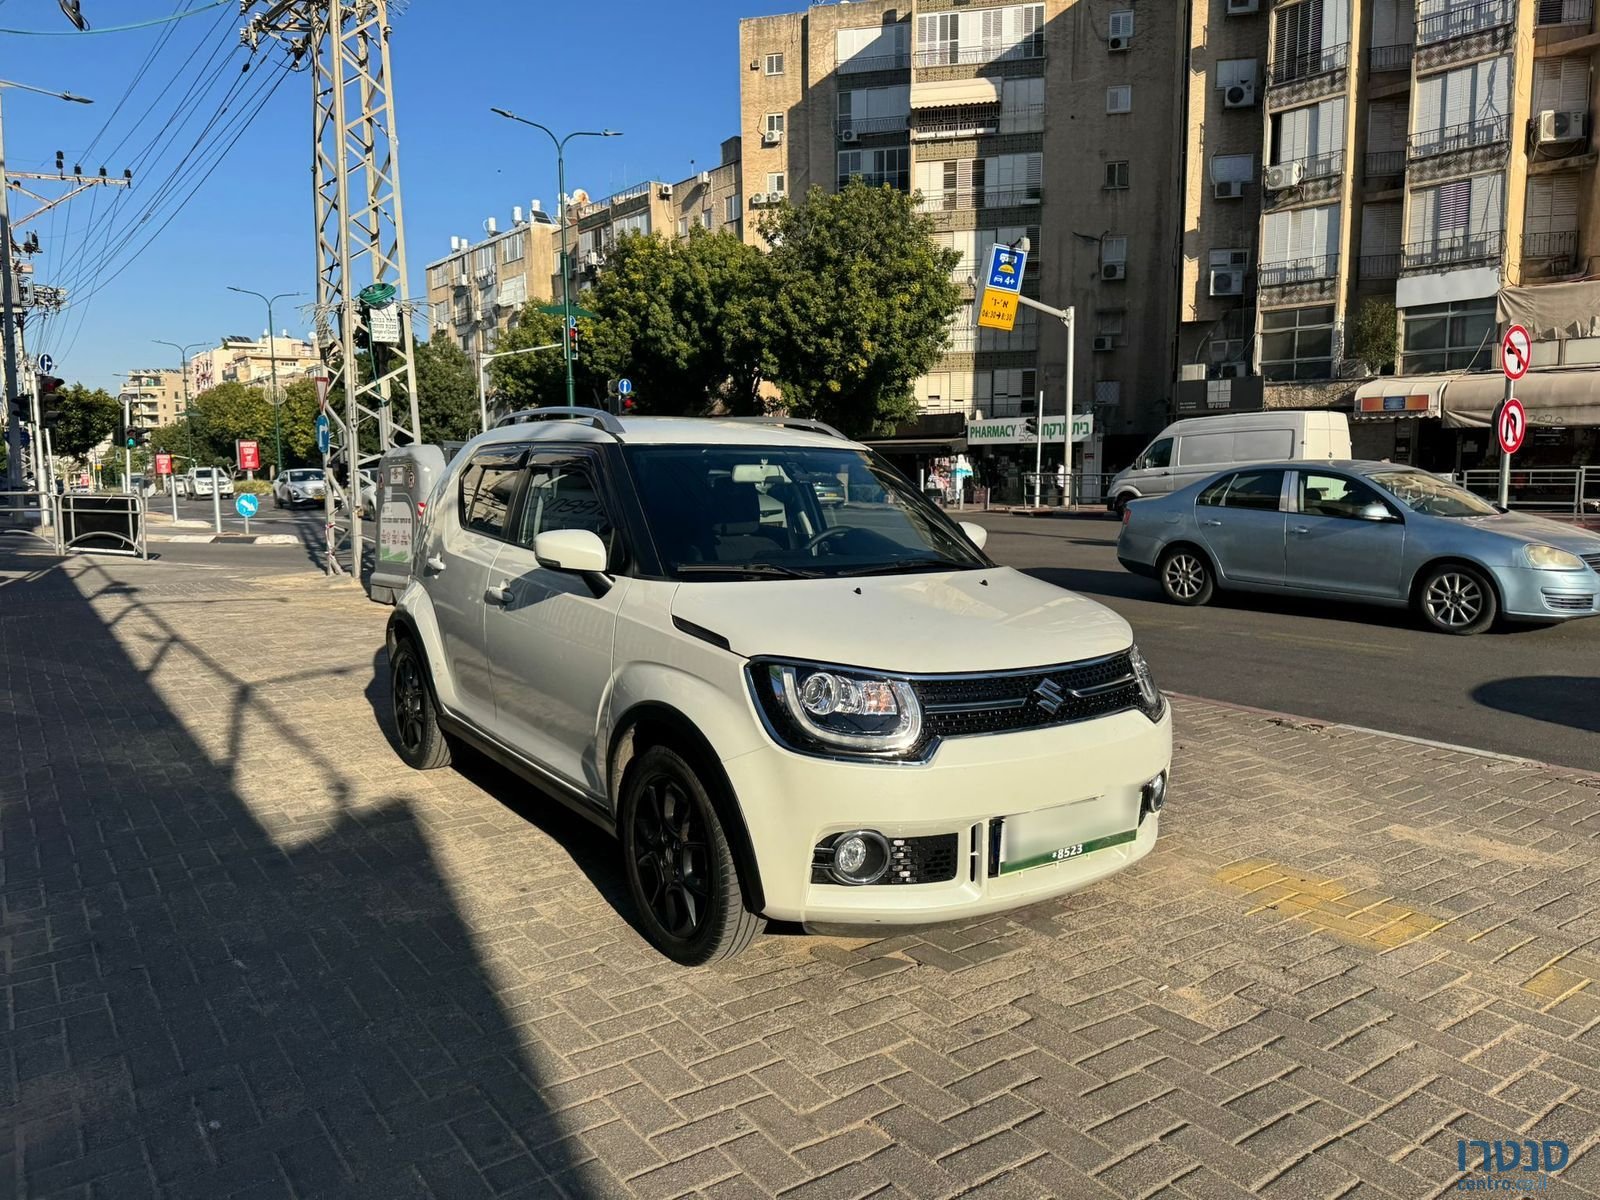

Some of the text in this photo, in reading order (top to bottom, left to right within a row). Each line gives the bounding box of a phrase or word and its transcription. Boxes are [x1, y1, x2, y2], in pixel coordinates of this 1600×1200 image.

[1004, 276, 1015, 285] 4+
[970, 424, 1017, 438] PHARMACY
[1071, 422, 1089, 435] בית
